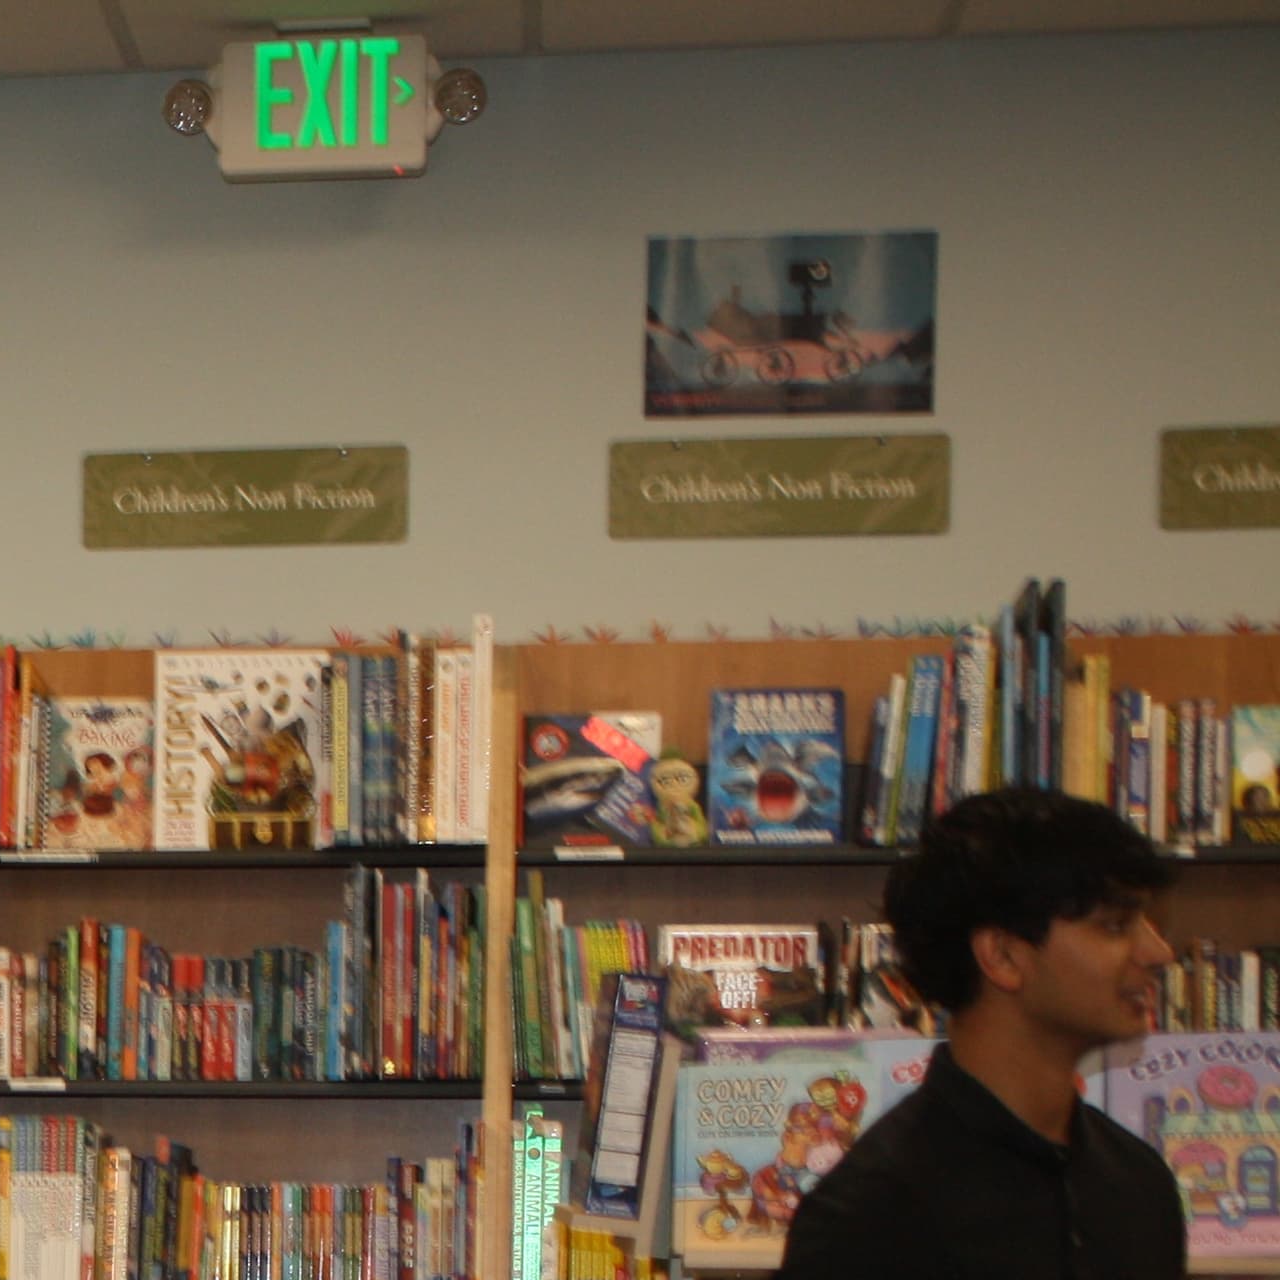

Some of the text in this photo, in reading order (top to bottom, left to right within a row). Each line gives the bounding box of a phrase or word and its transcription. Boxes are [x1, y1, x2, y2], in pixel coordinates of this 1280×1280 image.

[255, 38, 398, 149] EXIT
[234, 483, 288, 511] Non
[292, 481, 376, 511] Fiction
[767, 471, 824, 500] Non
[829, 470, 916, 499] Fiction
[78, 727, 137, 749] BAKING
[672, 935, 809, 968] PREDATOR
[719, 990, 758, 1009] OFF!
[696, 1075, 786, 1105] COMFY
[716, 1103, 785, 1128] COZY
[523, 1172, 542, 1237] ANIMAL!
